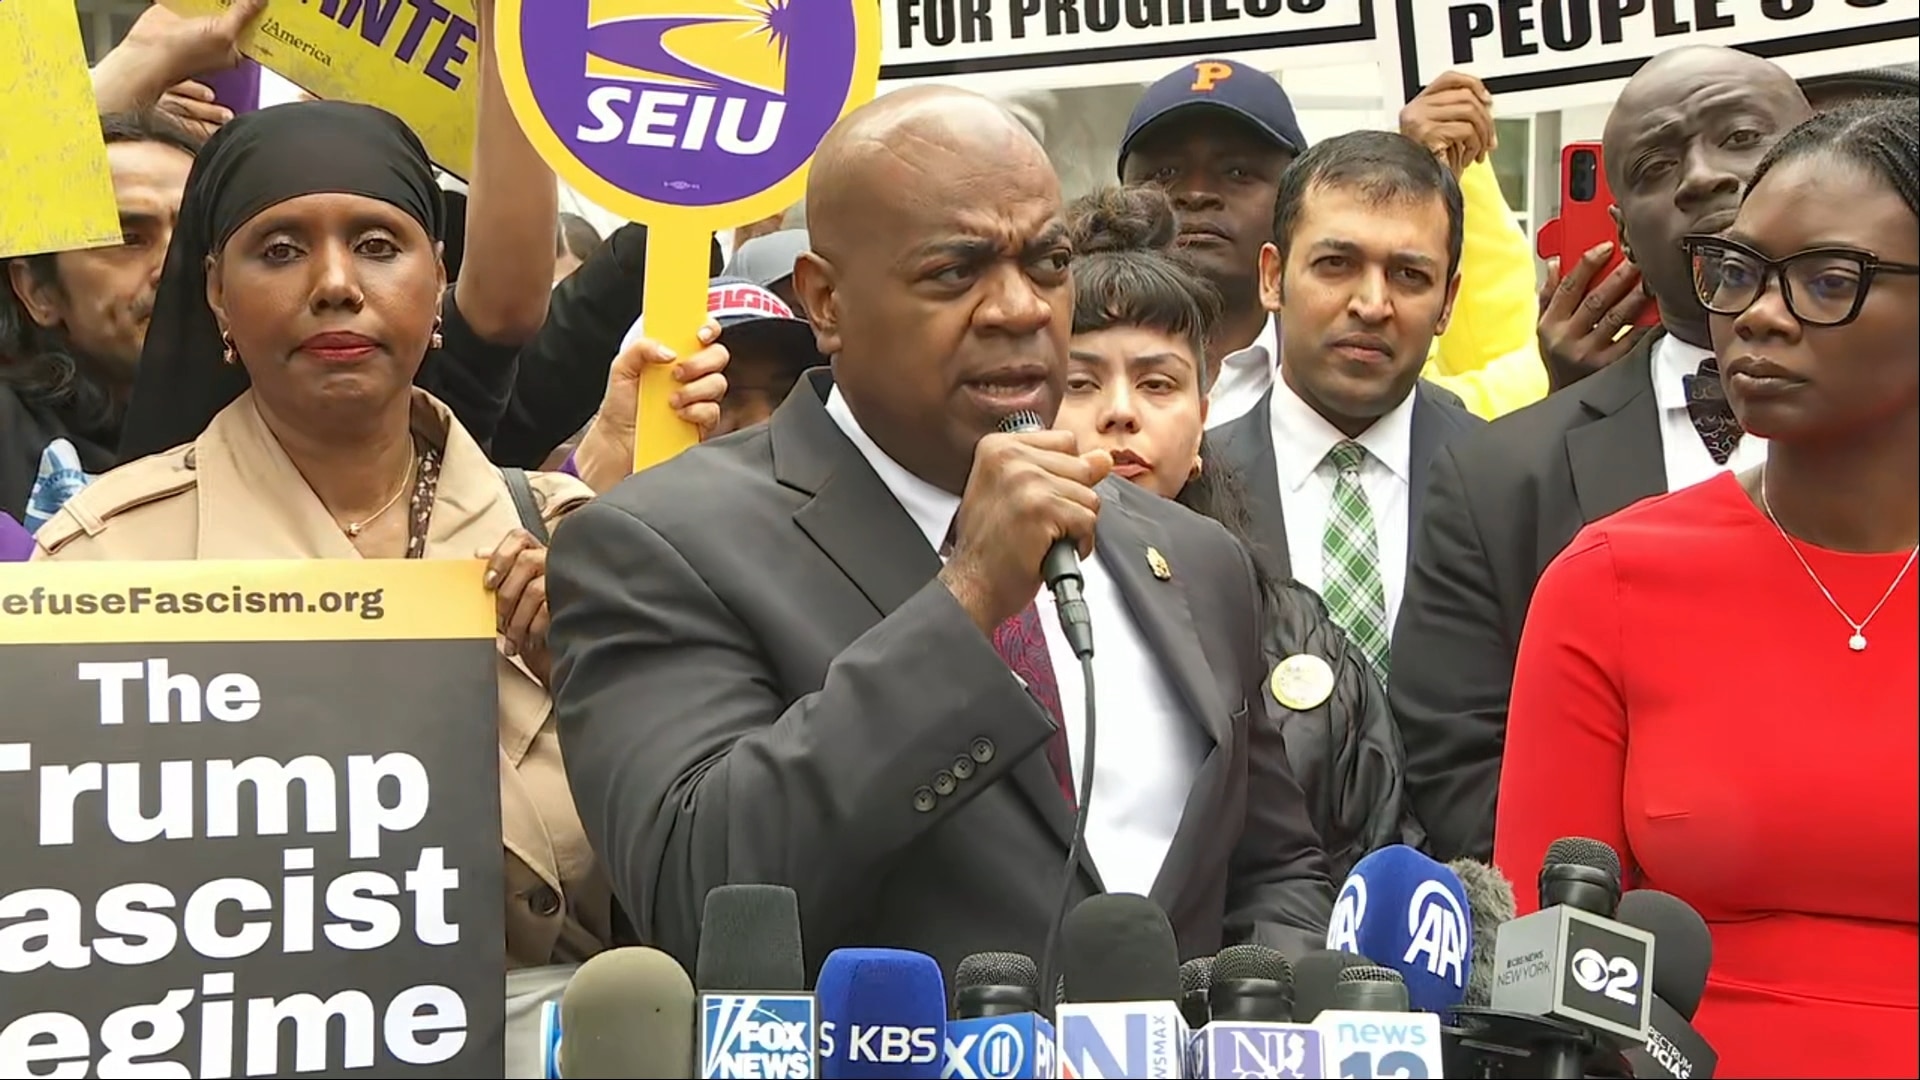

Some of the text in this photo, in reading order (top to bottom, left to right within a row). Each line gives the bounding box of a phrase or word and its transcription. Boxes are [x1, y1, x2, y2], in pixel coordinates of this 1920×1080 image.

[897, 0, 993, 48] FOR
[1448, 0, 1815, 64] PEOPLE
[1191, 62, 1232, 91] P
[576, 86, 787, 155] SEIU
[1, 586, 385, 620] efuseFascism.org
[79, 658, 261, 724] The
[0, 847, 460, 973] ascist
[1604, 956, 1638, 1005] 2
[0, 972, 468, 1079] egime
[739, 1021, 807, 1051] FOX
[848, 1025, 937, 1063] KBS
[1338, 1022, 1427, 1045] news
[1648, 1025, 1693, 1073] PECTRUM
[720, 1052, 809, 1079] NEWS
[1645, 1037, 1690, 1079] TICIAS
